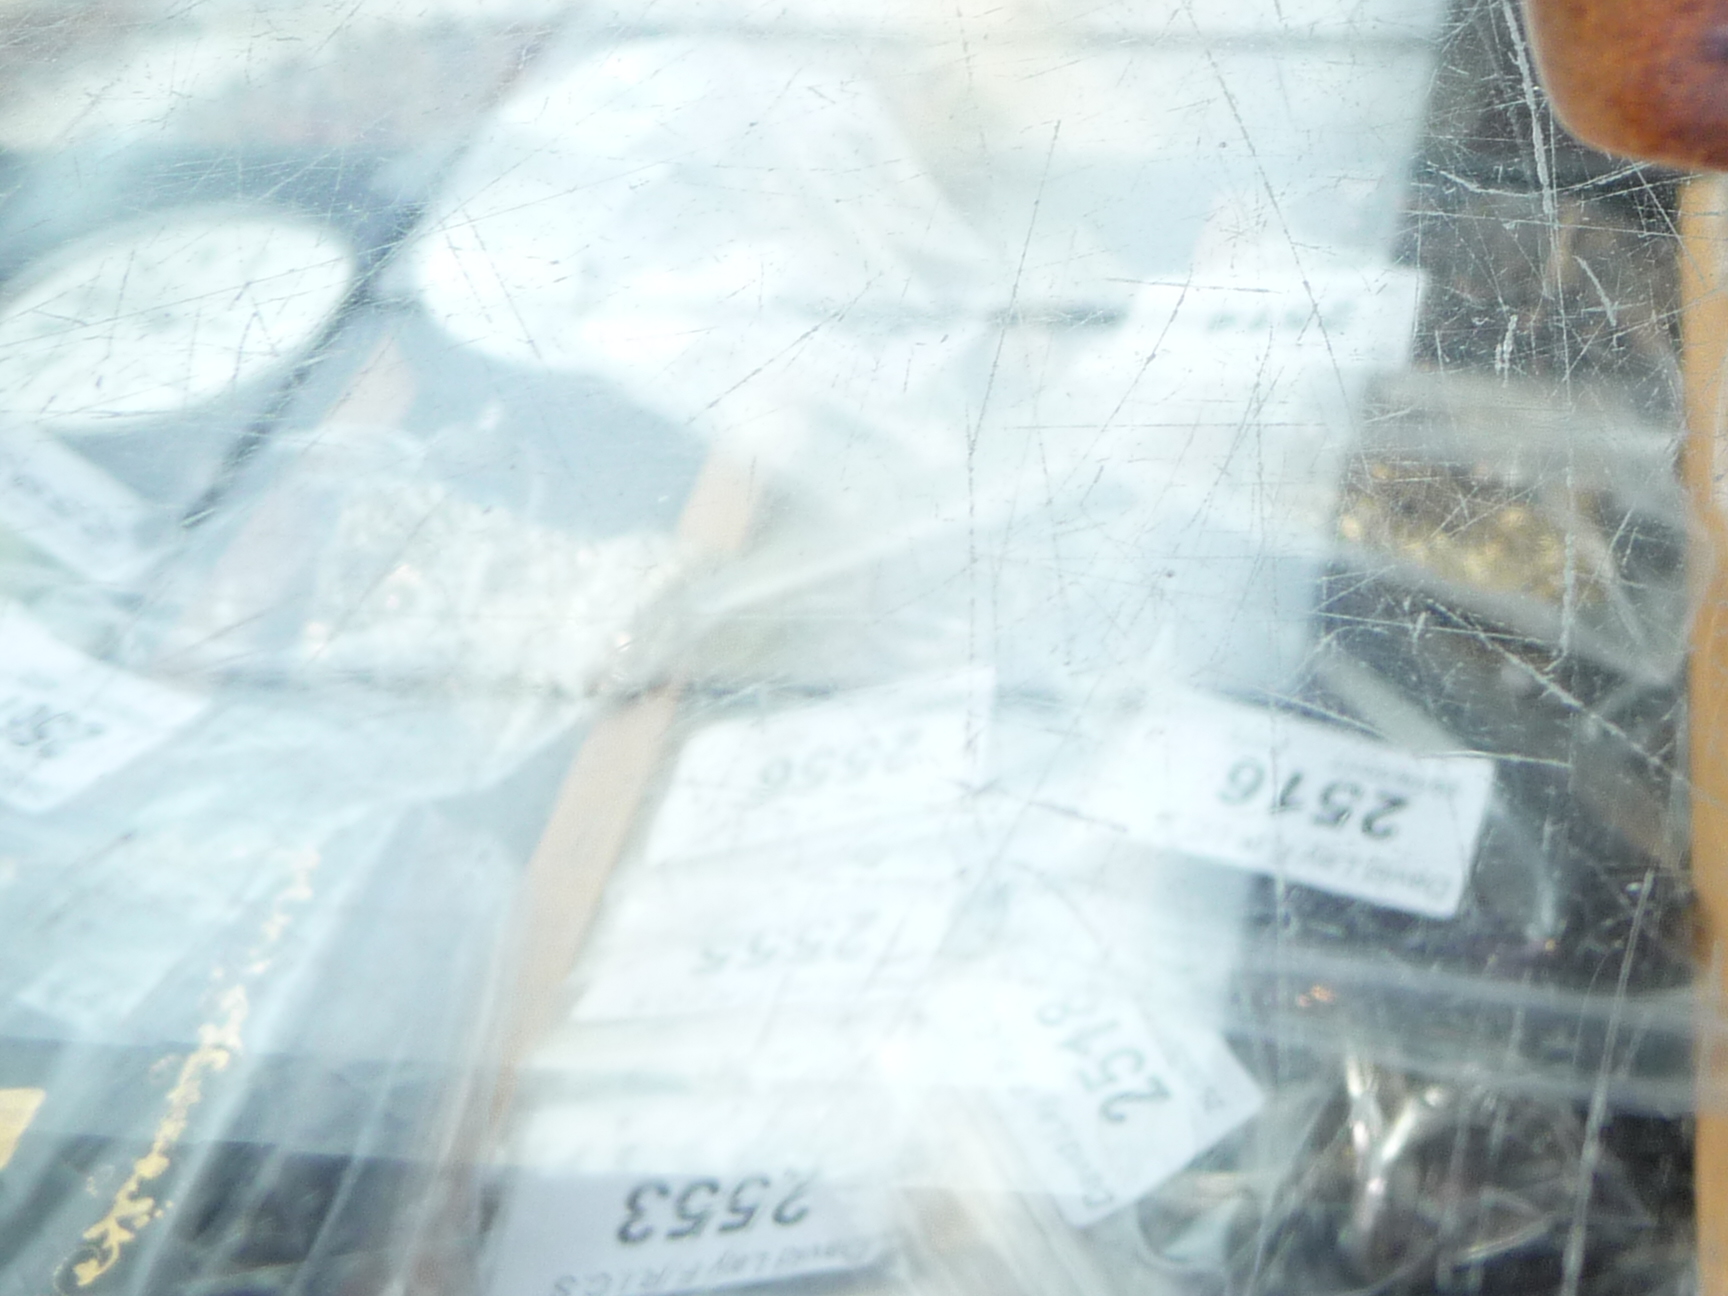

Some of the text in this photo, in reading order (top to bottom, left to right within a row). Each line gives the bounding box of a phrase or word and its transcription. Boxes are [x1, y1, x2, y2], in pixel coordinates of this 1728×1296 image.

[1216, 754, 1410, 842] 2516
[1033, 992, 1172, 1126] 2518
[616, 1169, 822, 1246] 2553
